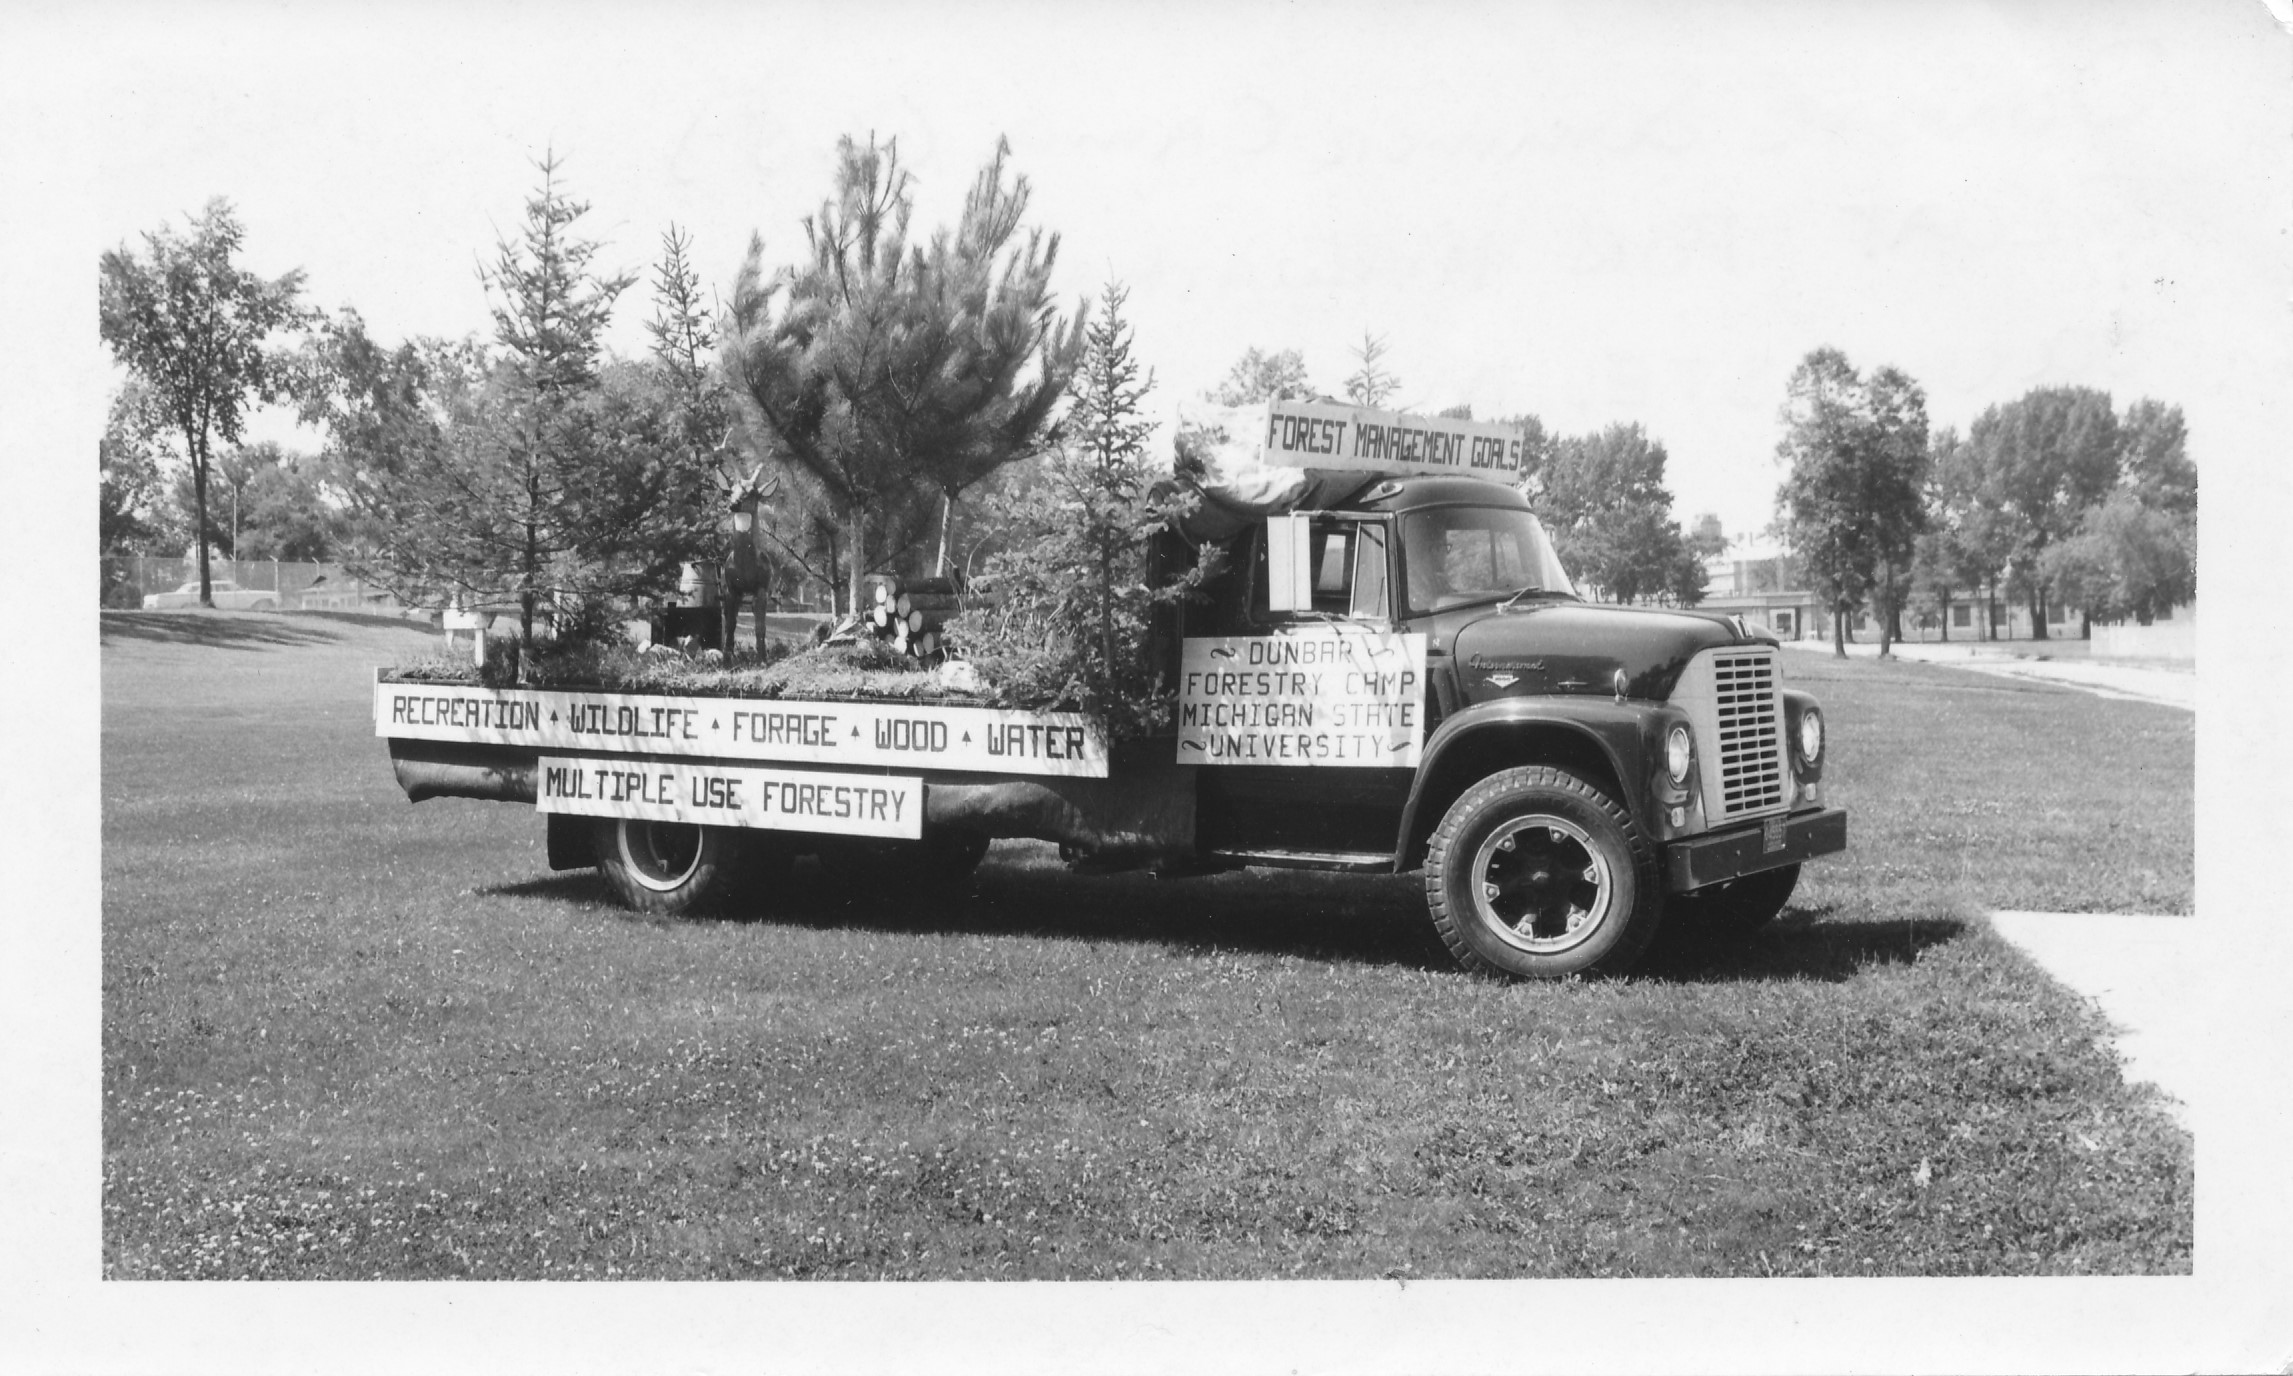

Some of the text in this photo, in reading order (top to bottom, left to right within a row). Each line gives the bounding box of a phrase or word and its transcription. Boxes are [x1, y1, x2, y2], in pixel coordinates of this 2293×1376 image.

[1268, 413, 1521, 471] FOREST MANAGEMENT GOALS
[1250, 641, 1352, 665] DUNBAR
[1187, 671, 1415, 696] FORESTRY CAMP
[1182, 703, 1415, 727] MICHIGAN STATE
[392, 695, 1086, 761] RECREATION WILDLIFE FORAGE WOOD WATER
[1210, 734, 1384, 759] UNIVERSITY
[546, 767, 906, 823] MULTIPLE USE FORESTRY
